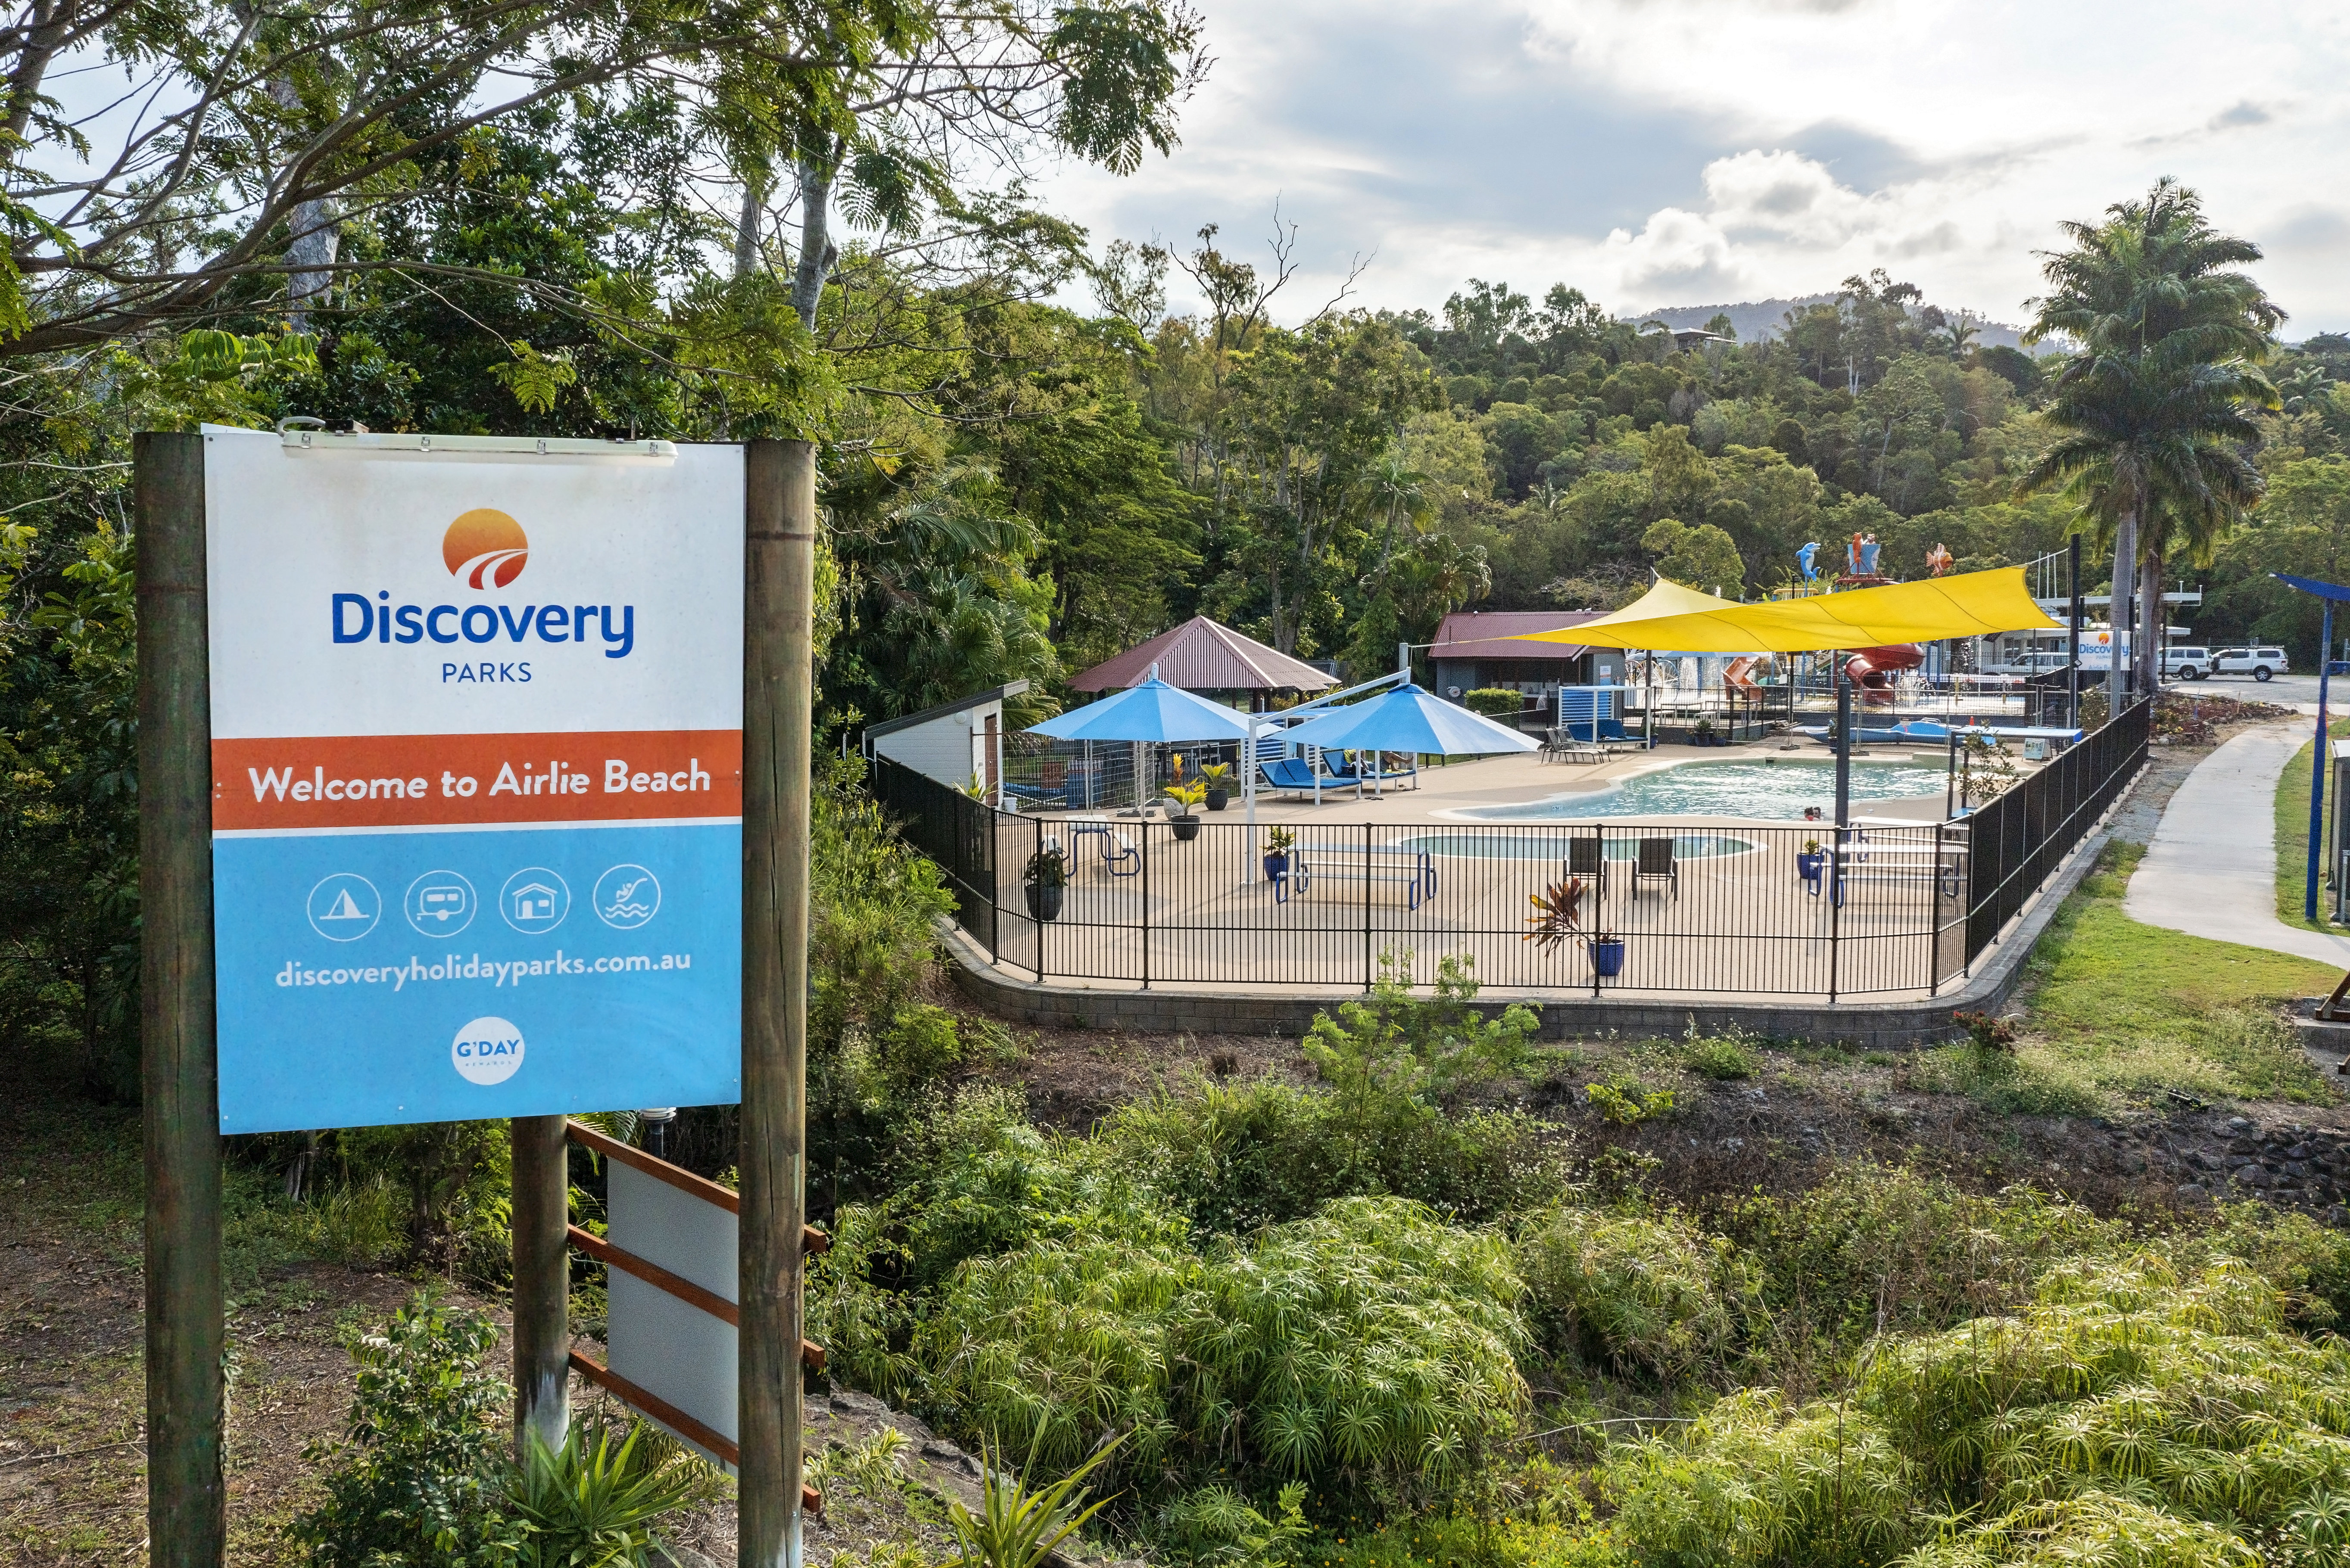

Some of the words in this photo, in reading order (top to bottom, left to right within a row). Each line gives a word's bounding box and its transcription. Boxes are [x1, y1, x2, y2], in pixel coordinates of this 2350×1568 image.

[332, 590, 634, 659] Discovery
[2079, 644, 2129, 656] Discovy
[443, 662, 532, 683] PARKS
[248, 766, 428, 803] Welcome
[441, 771, 478, 797] to
[489, 761, 590, 796] Airlie
[604, 758, 711, 793] Beach
[276, 950, 691, 992] discoveryholidayparks.com.au
[457, 1039, 520, 1058] G'DAY
